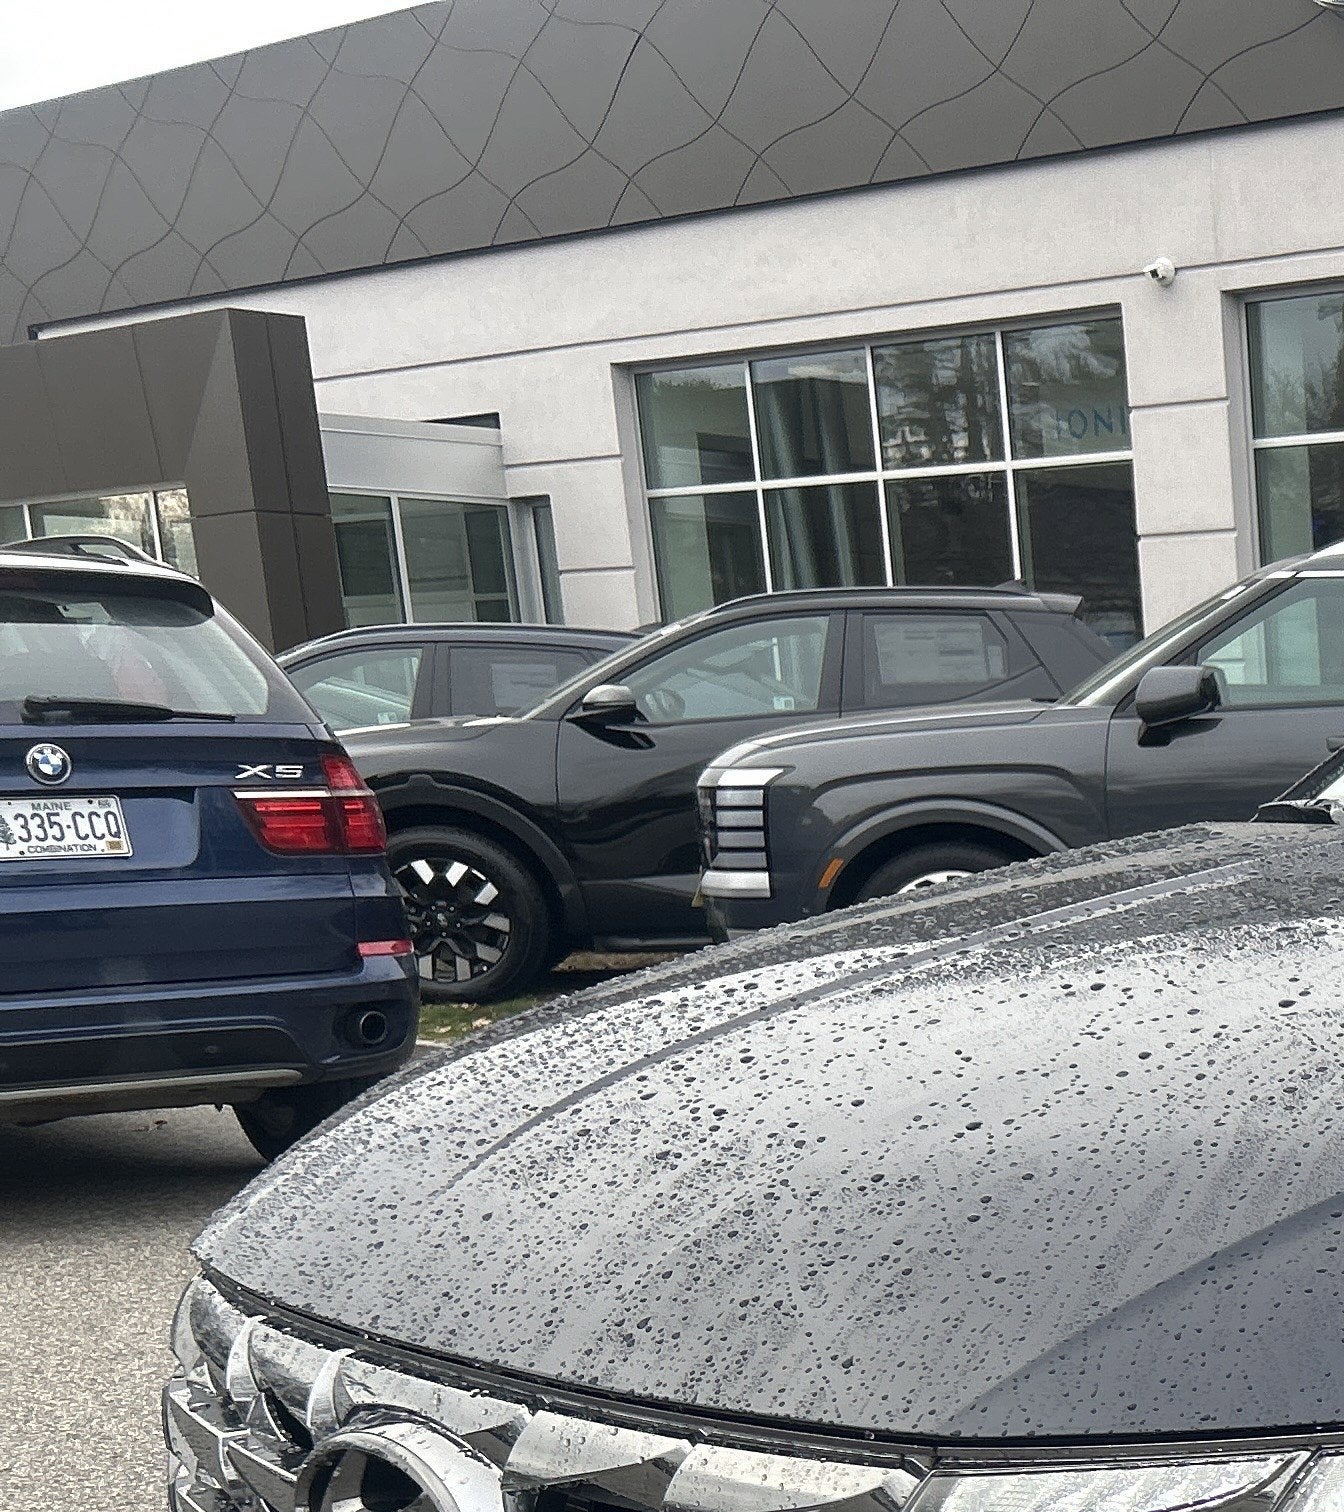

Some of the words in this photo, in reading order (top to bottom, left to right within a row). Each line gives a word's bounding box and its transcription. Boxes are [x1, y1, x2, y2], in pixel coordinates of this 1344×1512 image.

[1056, 404, 1126, 440] IONI
[234, 764, 304, 780] X5
[31, 801, 73, 811] MAINE
